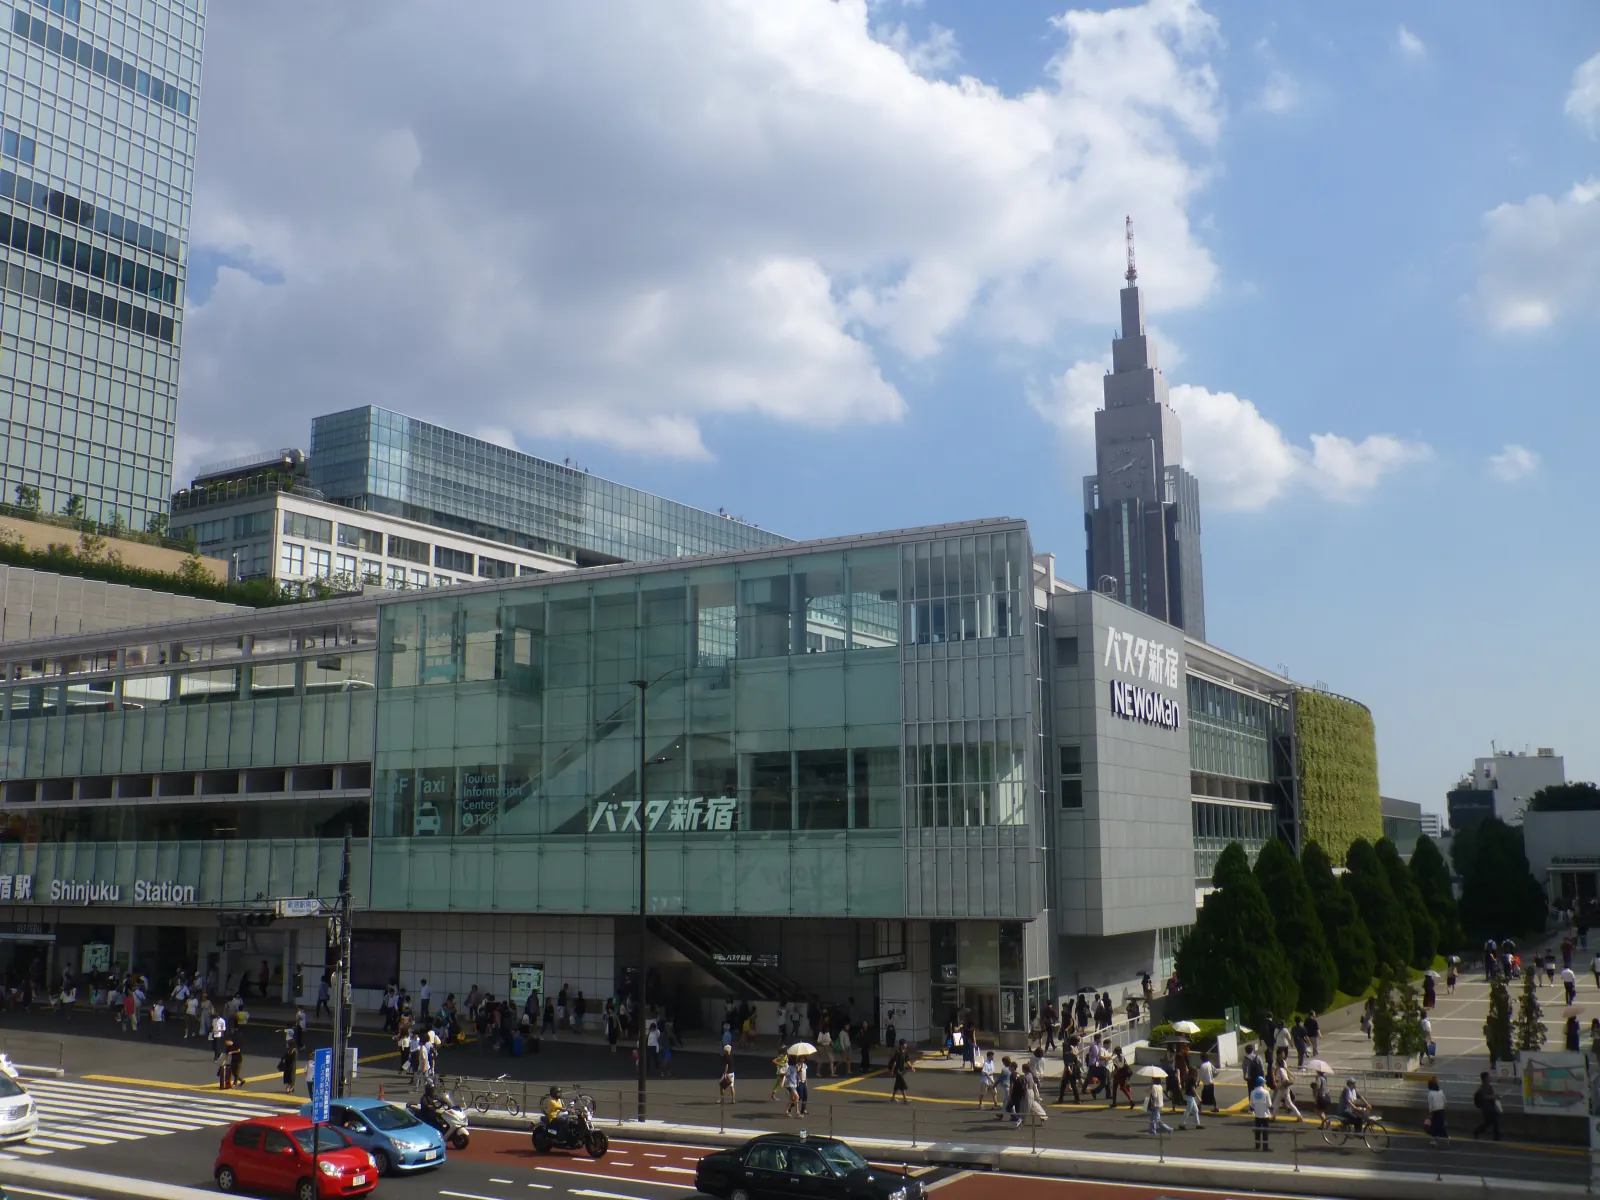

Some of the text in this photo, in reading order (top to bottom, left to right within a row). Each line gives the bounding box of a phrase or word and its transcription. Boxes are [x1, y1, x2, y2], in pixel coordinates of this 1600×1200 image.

[1104, 626, 1178, 688] バスタ新宿
[1113, 680, 1180, 727] NEWoMan
[417, 776, 446, 793] Taxi
[463, 772, 497, 784] Tourist
[462, 799, 496, 810] Center
[588, 795, 737, 832] バスタ新宿
[50, 879, 195, 906] Shinjuku Station
